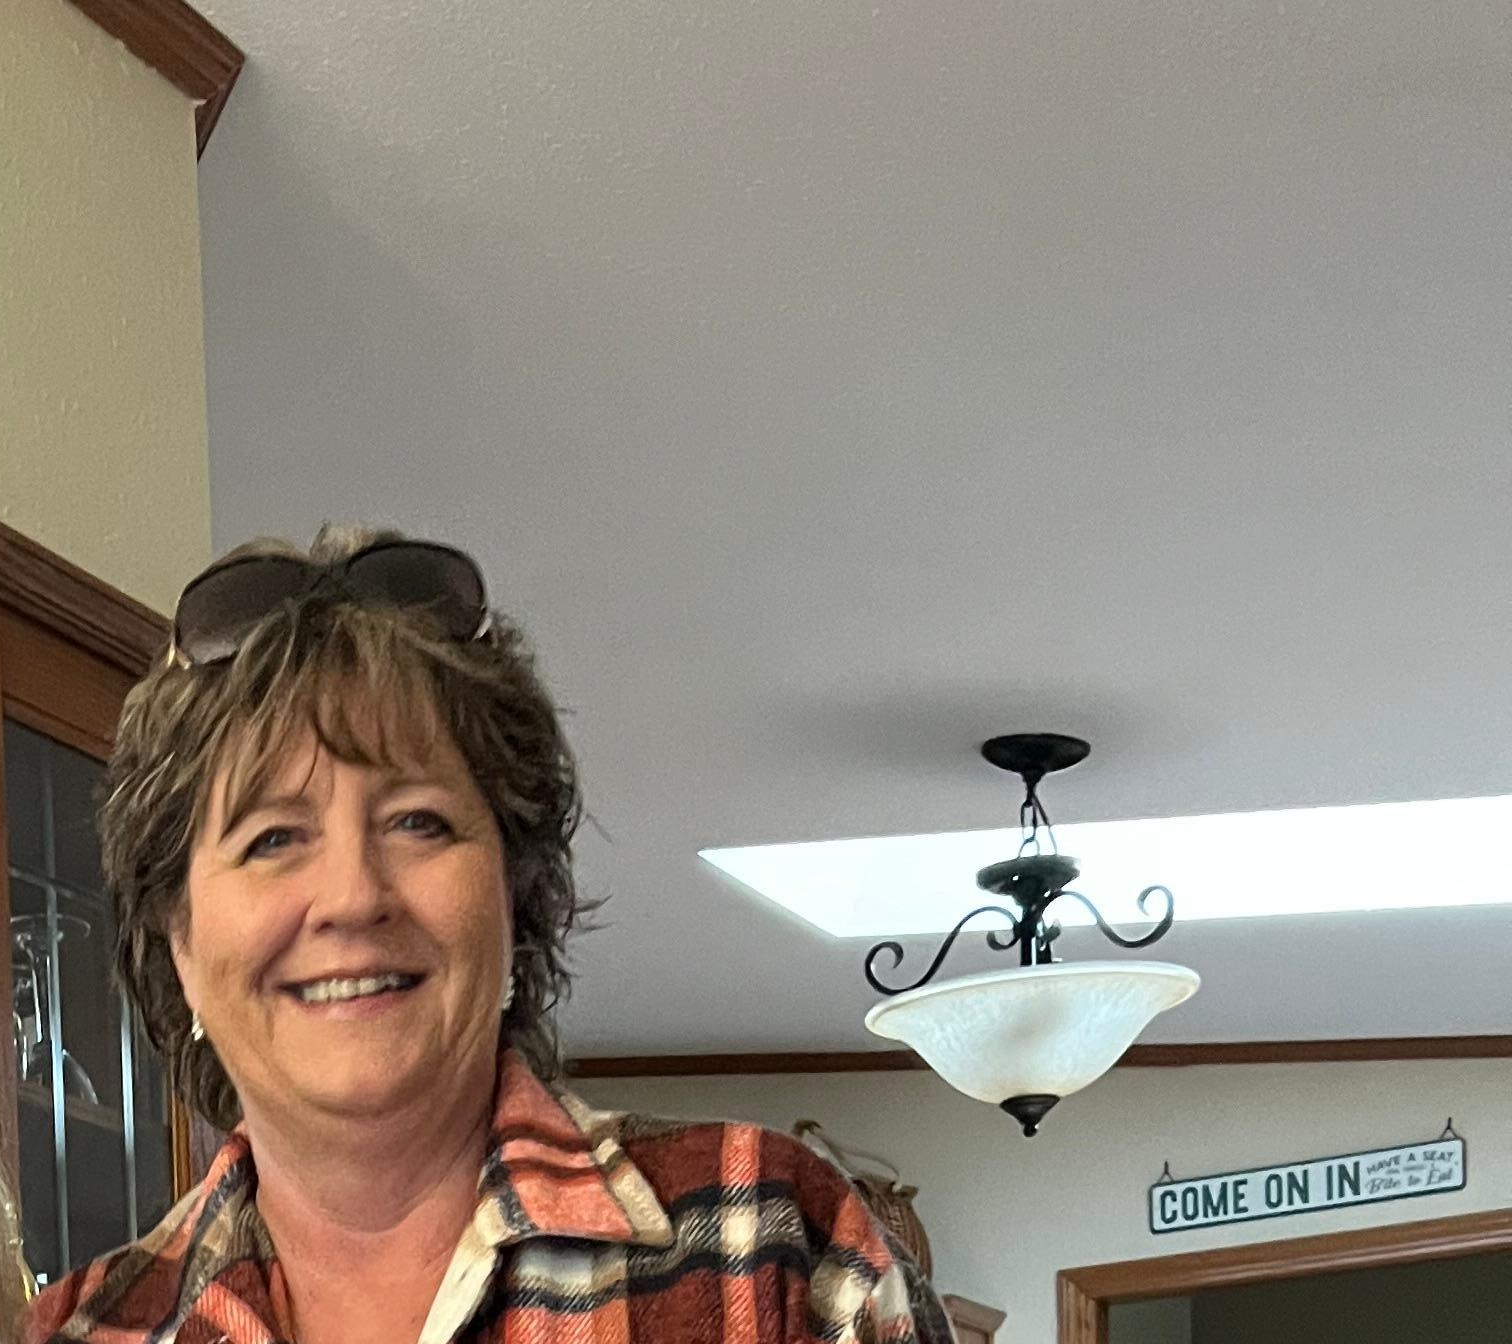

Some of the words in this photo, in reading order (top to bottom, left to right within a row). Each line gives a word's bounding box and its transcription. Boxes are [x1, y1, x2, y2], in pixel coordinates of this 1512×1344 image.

[1367, 1155, 1401, 1175] HAVE
[1407, 1152, 1416, 1162] A
[1160, 1178, 1249, 1225] COME
[1264, 1169, 1310, 1208] ON
[1326, 1161, 1361, 1200] IN
